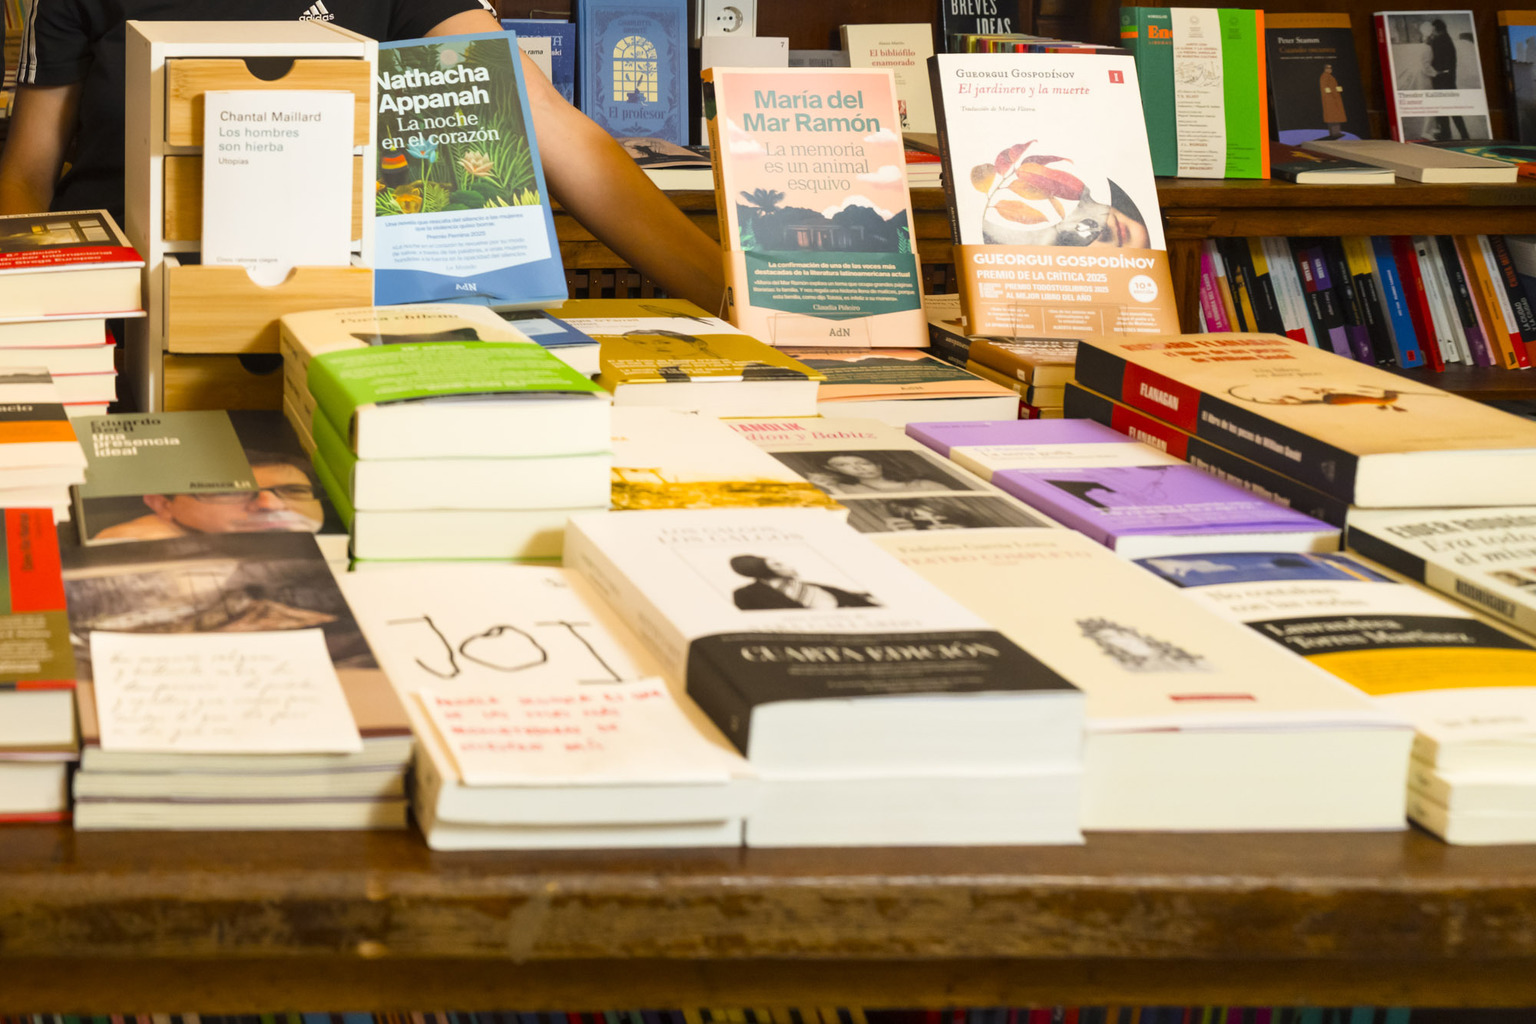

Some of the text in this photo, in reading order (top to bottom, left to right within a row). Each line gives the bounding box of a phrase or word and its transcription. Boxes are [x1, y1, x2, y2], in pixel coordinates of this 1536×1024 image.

[299, 12, 335, 22] adidas
[976, 17, 1012, 34] IDEAS
[869, 47, 916, 57] El bibliófilo
[871, 58, 916, 67] enamorado
[375, 64, 490, 92] Nathacha
[958, 82, 1090, 98] El jardinero y la muerte
[378, 86, 490, 114] Appanah
[754, 90, 864, 109] María del
[220, 111, 322, 124] Chantal Maillard
[397, 112, 479, 132] La noche
[608, 107, 667, 121] El profesor
[743, 111, 881, 134] Mar Ramón
[218, 126, 300, 139] Los hombres
[381, 127, 500, 150] en el corazón
[218, 141, 284, 153] son hierba
[765, 141, 865, 158] La memoria
[764, 158, 870, 174] es un animal
[787, 176, 851, 193] esquivo
[41, 249, 113, 261] Internacional
[973, 253, 1155, 269] GUEORGUI GOSPODÍNOV
[977, 269, 1107, 283] PREMIO DE LA CRÍTICA 2025
[828, 327, 851, 337] AdN
[1140, 382, 1179, 411] FLANAGAN
[91, 418, 163, 428] Eduardo
[740, 642, 858, 665] CUARTA
